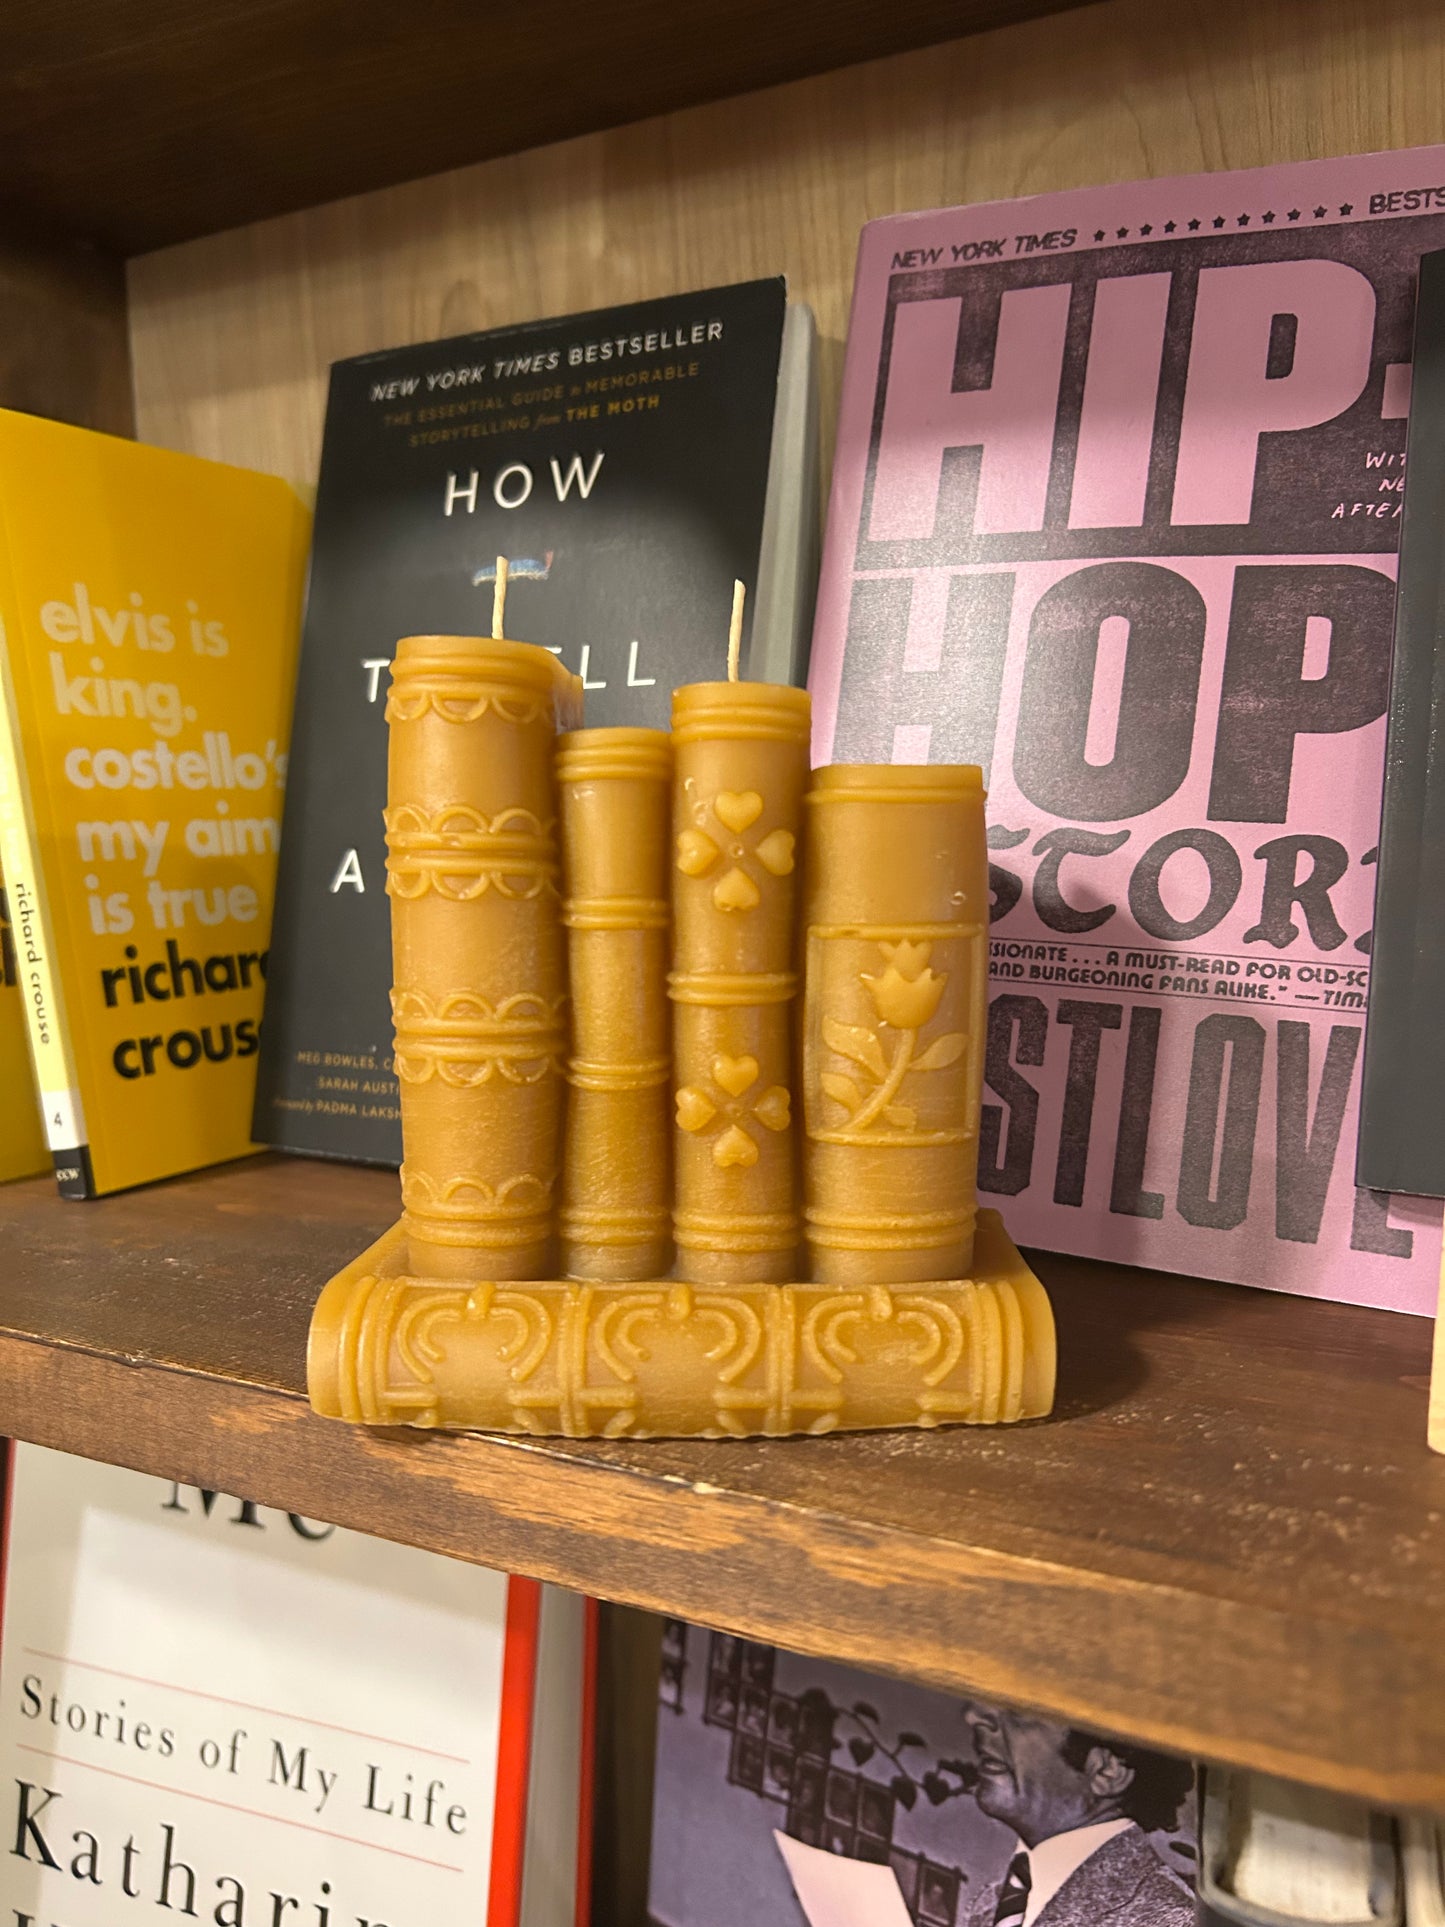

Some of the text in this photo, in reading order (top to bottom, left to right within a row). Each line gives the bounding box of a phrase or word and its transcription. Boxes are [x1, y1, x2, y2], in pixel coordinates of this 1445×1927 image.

[891, 248, 943, 269] NEW
[951, 238, 1006, 262] YORK
[1014, 228, 1078, 255] TIMES
[371, 321, 723, 402] NEW YORK TIMES BESTSELLER
[384, 411, 412, 426] THE
[417, 397, 505, 423] ESSENTIAL
[511, 385, 564, 406] GUIDE
[585, 362, 699, 395] MEMORABLE
[408, 415, 531, 448] STORYTELLING
[566, 405, 600, 423] THE
[607, 394, 660, 416] MOTH
[444, 453, 605, 516] HOW
[40, 581, 229, 657] elvis is
[48, 651, 197, 738] king.
[831, 561, 1397, 825] HOP
[76, 799, 280, 877] my aim
[331, 848, 365, 893] A
[84, 874, 258, 936] is true
[16, 882, 50, 1044] richard crouse
[989, 961, 1025, 978] AND
[1029, 964, 1154, 989] BURGEONING
[1159, 975, 1209, 994] FANS
[1323, 989, 1368, 1009] TIM
[1106, 950, 1119, 966] A
[1125, 952, 1240, 977] MUST-READ
[1246, 962, 1291, 981] FOR
[113, 1019, 261, 1081] crous
[318, 1075, 358, 1091] SARAH
[20, 1674, 468, 1836] Stories of My Life
[9, 1778, 392, 1927] Kathari
